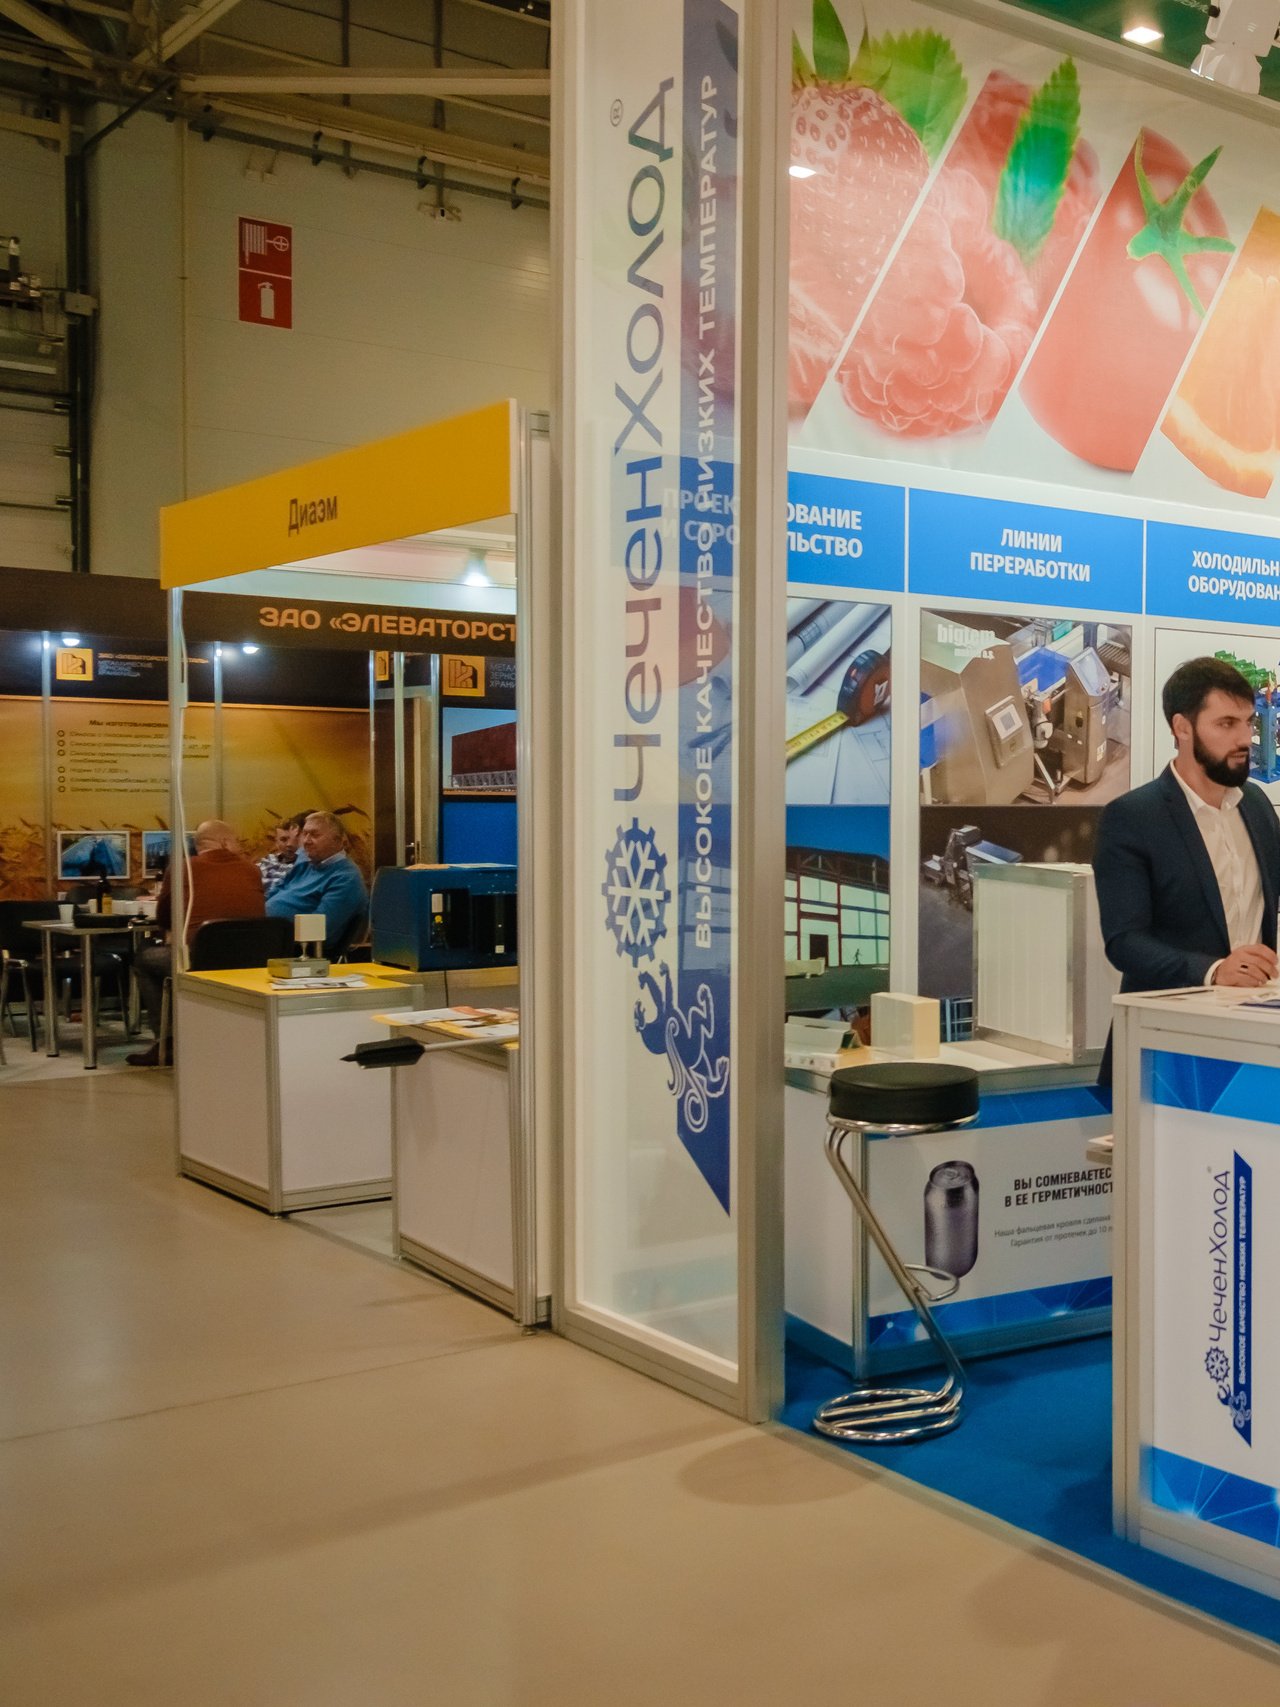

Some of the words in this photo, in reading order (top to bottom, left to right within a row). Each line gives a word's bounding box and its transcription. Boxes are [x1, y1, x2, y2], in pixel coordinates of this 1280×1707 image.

[700, 74, 719, 341] ТЕМПЕРАТУР
[697, 349, 716, 510] НИЗКИХ
[288, 496, 338, 537] Диаэм
[1000, 528, 1062, 554] ЛИНИИ
[970, 551, 1091, 583] ПЕРЕРАБОТКИ
[259, 606, 321, 629] ЗАО
[695, 522, 715, 734] КАЧЕСТВО
[695, 746, 713, 949] ВЫСОКОЕ
[1004, 1195, 1011, 1207] В
[1015, 1193, 1028, 1206] ЕЕ
[1014, 1178, 1032, 1191] ВЫ
